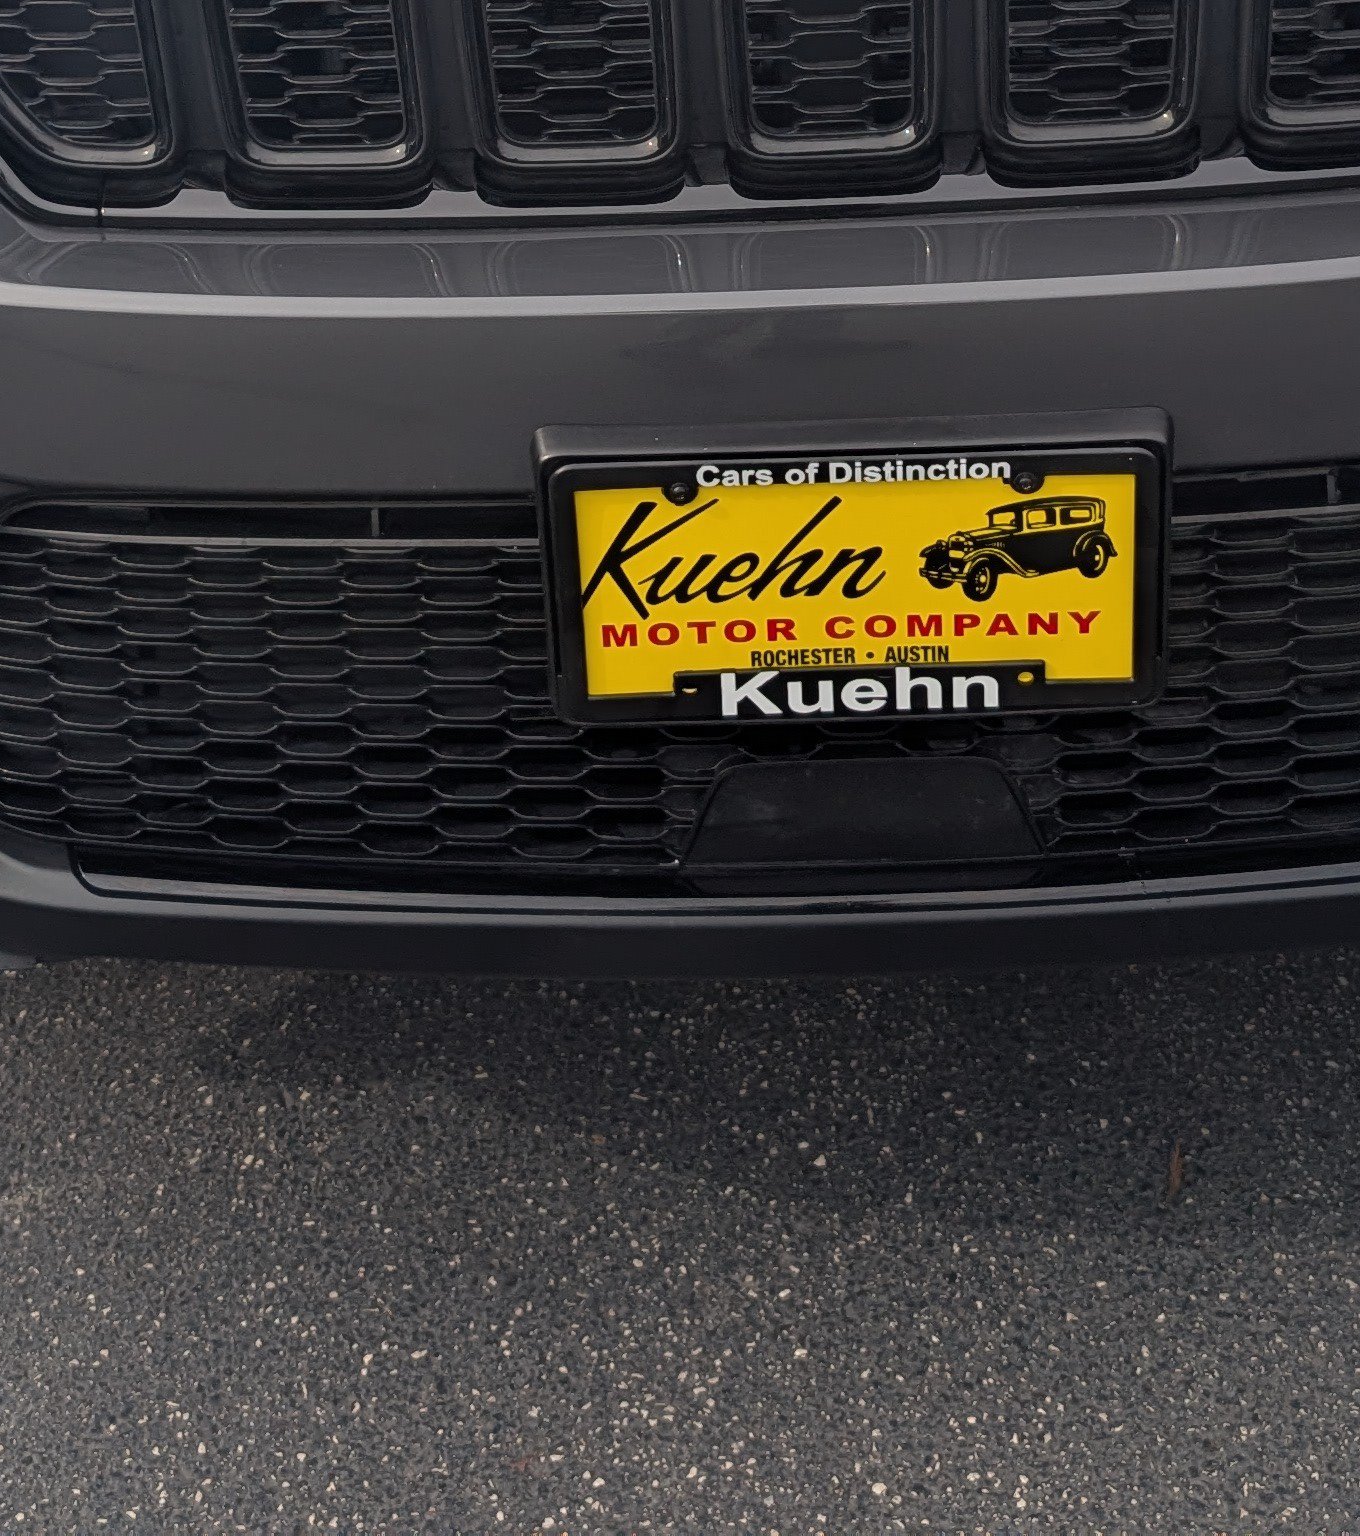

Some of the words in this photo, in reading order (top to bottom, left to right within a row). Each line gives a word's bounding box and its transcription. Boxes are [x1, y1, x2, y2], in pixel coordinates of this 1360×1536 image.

[696, 464, 773, 487] Cars
[785, 463, 819, 484] of
[829, 458, 1011, 484] Distinction
[582, 496, 886, 620] Kuehn
[602, 617, 797, 648] MOTOR
[825, 610, 1102, 640] COMPANY
[751, 647, 856, 667] ROCHESTER
[884, 645, 950, 664] AUSTIN
[720, 666, 1000, 716] Kuehn
